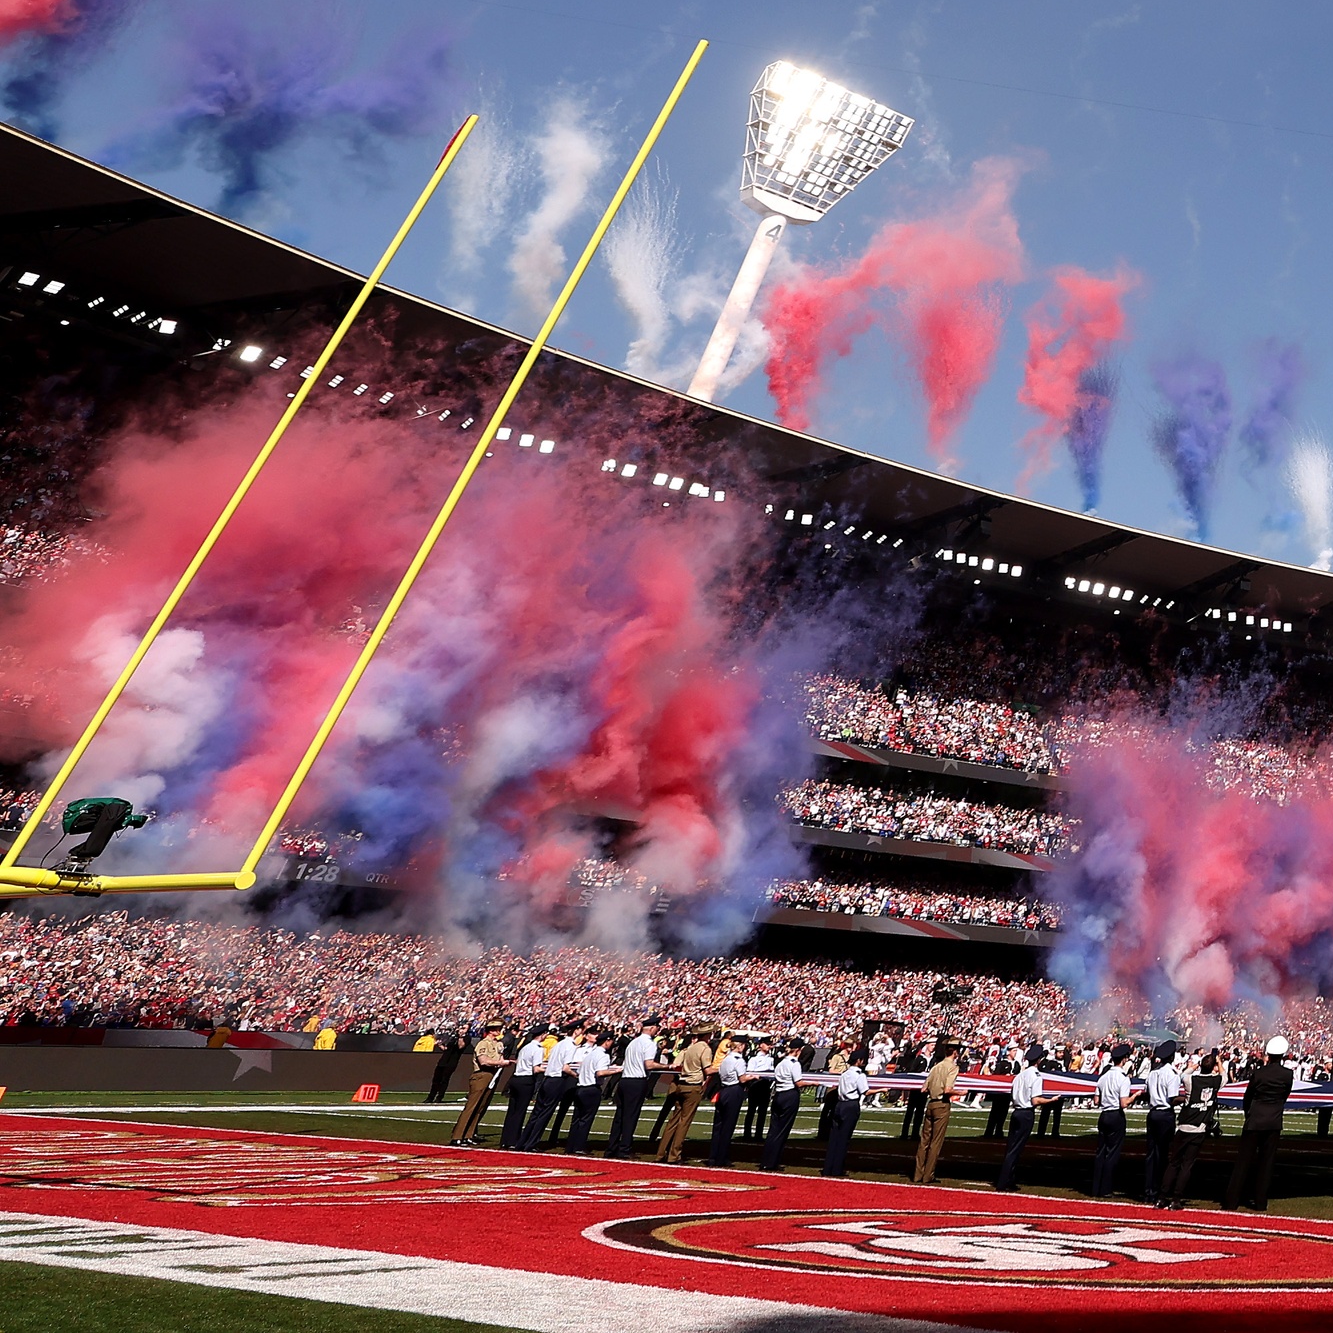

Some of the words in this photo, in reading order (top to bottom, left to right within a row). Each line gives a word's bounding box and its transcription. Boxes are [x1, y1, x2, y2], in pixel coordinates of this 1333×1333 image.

[765, 224, 782, 243] 4
[296, 863, 340, 882] 1:28
[366, 872, 389, 884] QTR
[362, 1086, 377, 1100] 10
